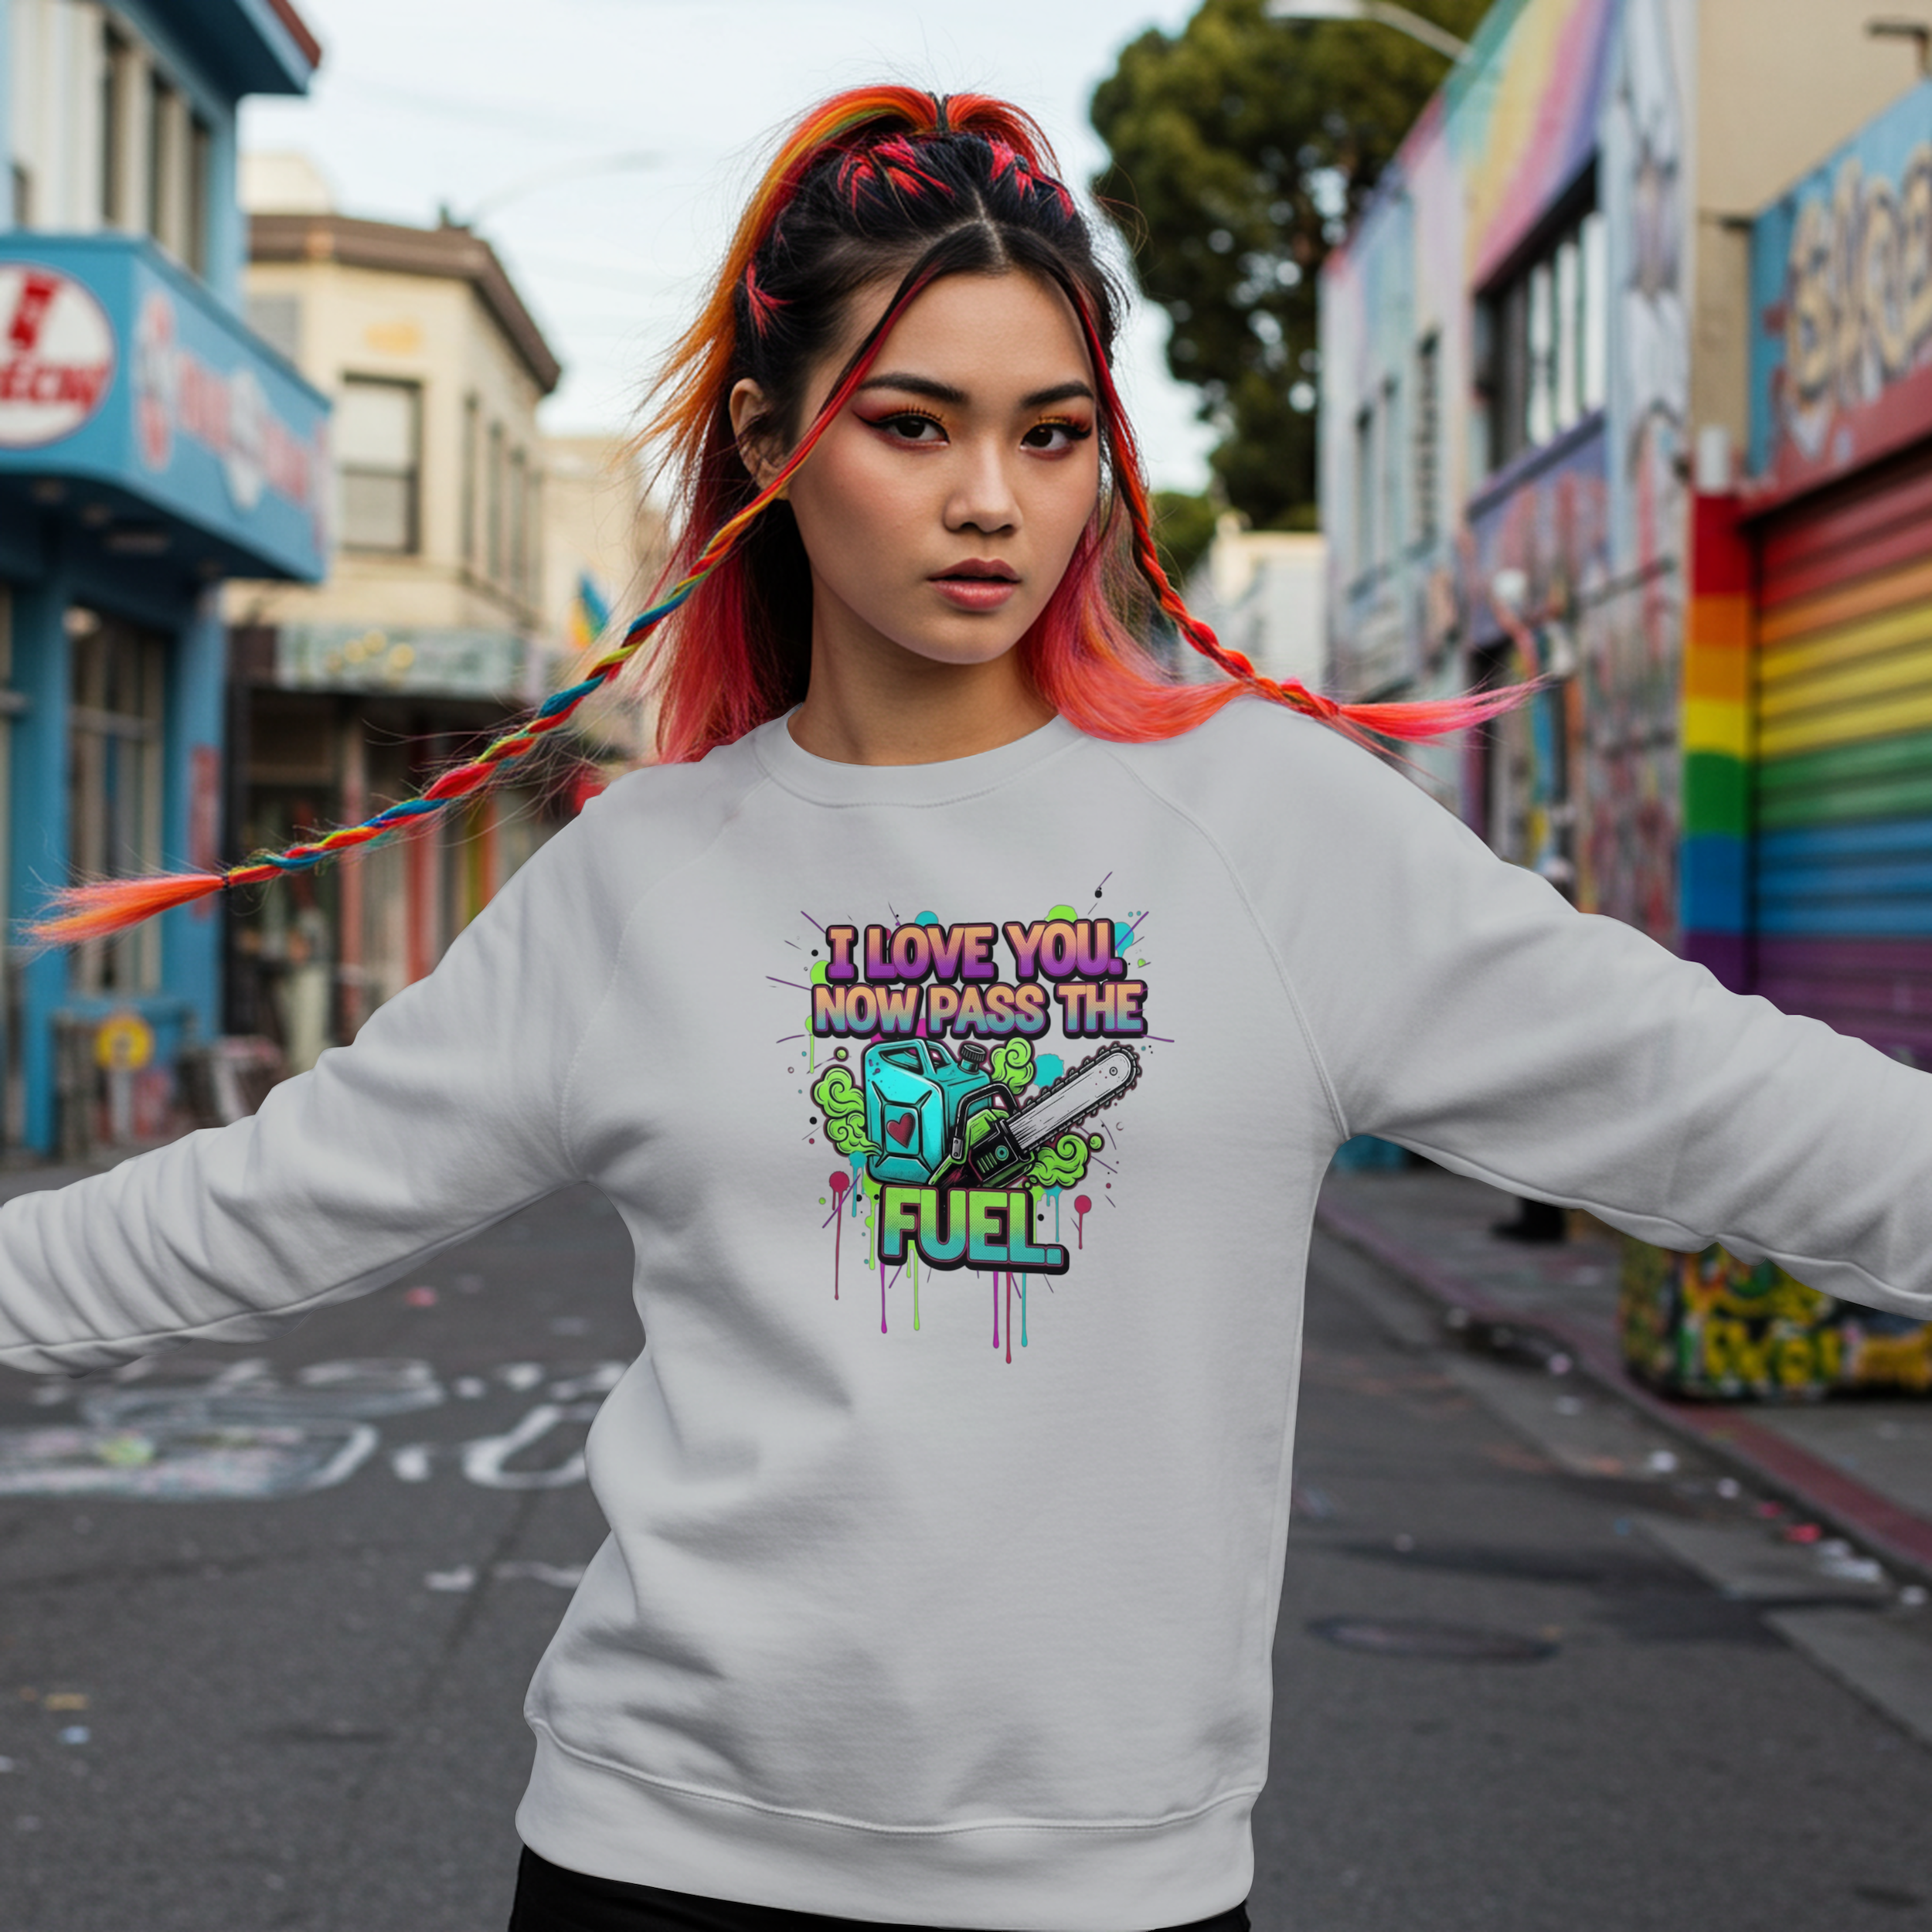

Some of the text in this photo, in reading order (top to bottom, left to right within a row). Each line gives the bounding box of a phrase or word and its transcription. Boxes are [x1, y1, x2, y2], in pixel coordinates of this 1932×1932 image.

[826, 919, 1127, 985] I LOVE YOU.
[811, 980, 1147, 1039] NOW PASS THE
[878, 1184, 1070, 1274] FUEL.
